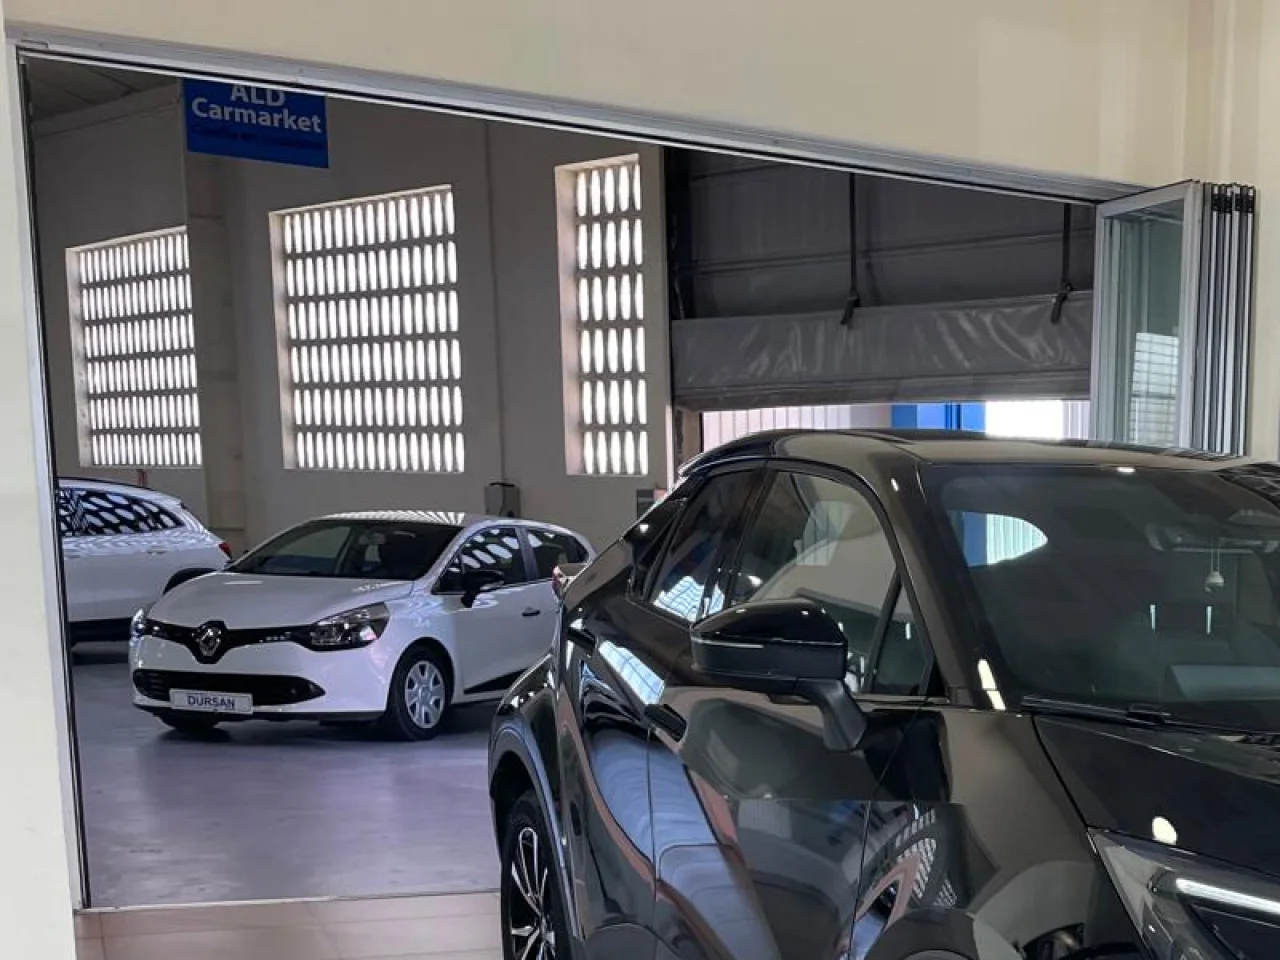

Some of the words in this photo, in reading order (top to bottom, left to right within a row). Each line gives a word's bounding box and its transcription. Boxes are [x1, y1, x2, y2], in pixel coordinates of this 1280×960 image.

[230, 84, 285, 106] ALD
[192, 97, 322, 133] Carmarket
[187, 695, 235, 709] DURSAN
